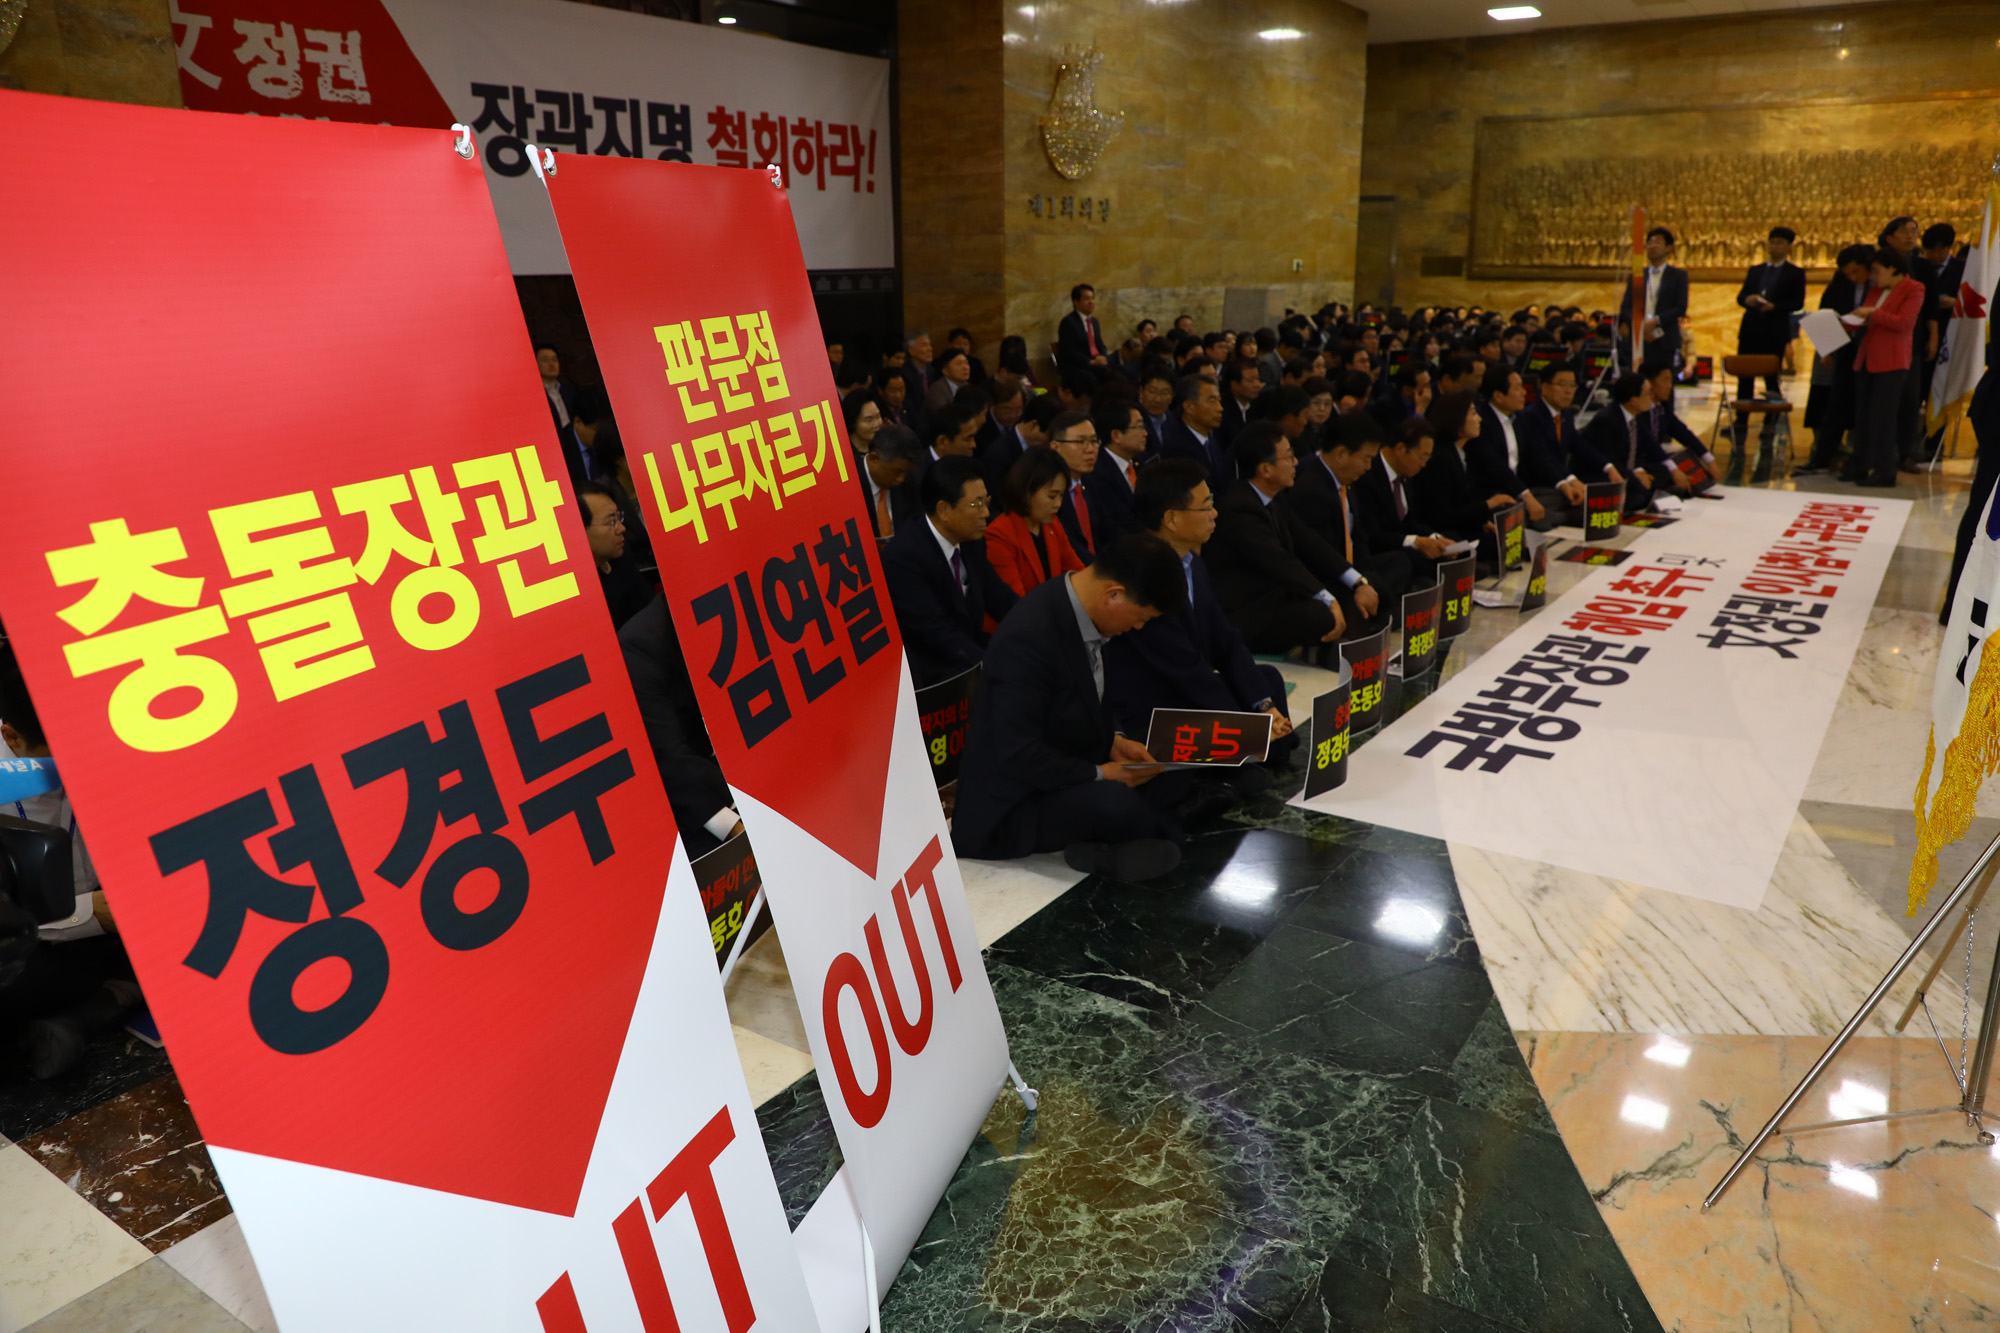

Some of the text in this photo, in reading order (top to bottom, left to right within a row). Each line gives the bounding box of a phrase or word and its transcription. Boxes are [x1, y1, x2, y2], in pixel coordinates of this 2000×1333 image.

[233, 18, 371, 105] 정권
[470, 82, 877, 194] 장관지명 철회하라!
[653, 310, 790, 424] 판문점
[643, 400, 849, 544] 나무자르기
[45, 445, 580, 752] 충돌장관
[690, 517, 891, 750] 김연철
[1561, 595, 1689, 636] 해임
[1608, 565, 1715, 598] 촉구
[1696, 593, 1829, 660] 文정권
[930, 734, 947, 765] 영
[1209, 721, 1242, 760] UT
[1350, 680, 1383, 715] 조동호
[1403, 634, 1651, 774] 국방부장관
[149, 653, 636, 1055] 정경두
[822, 833, 963, 1129] OUT
